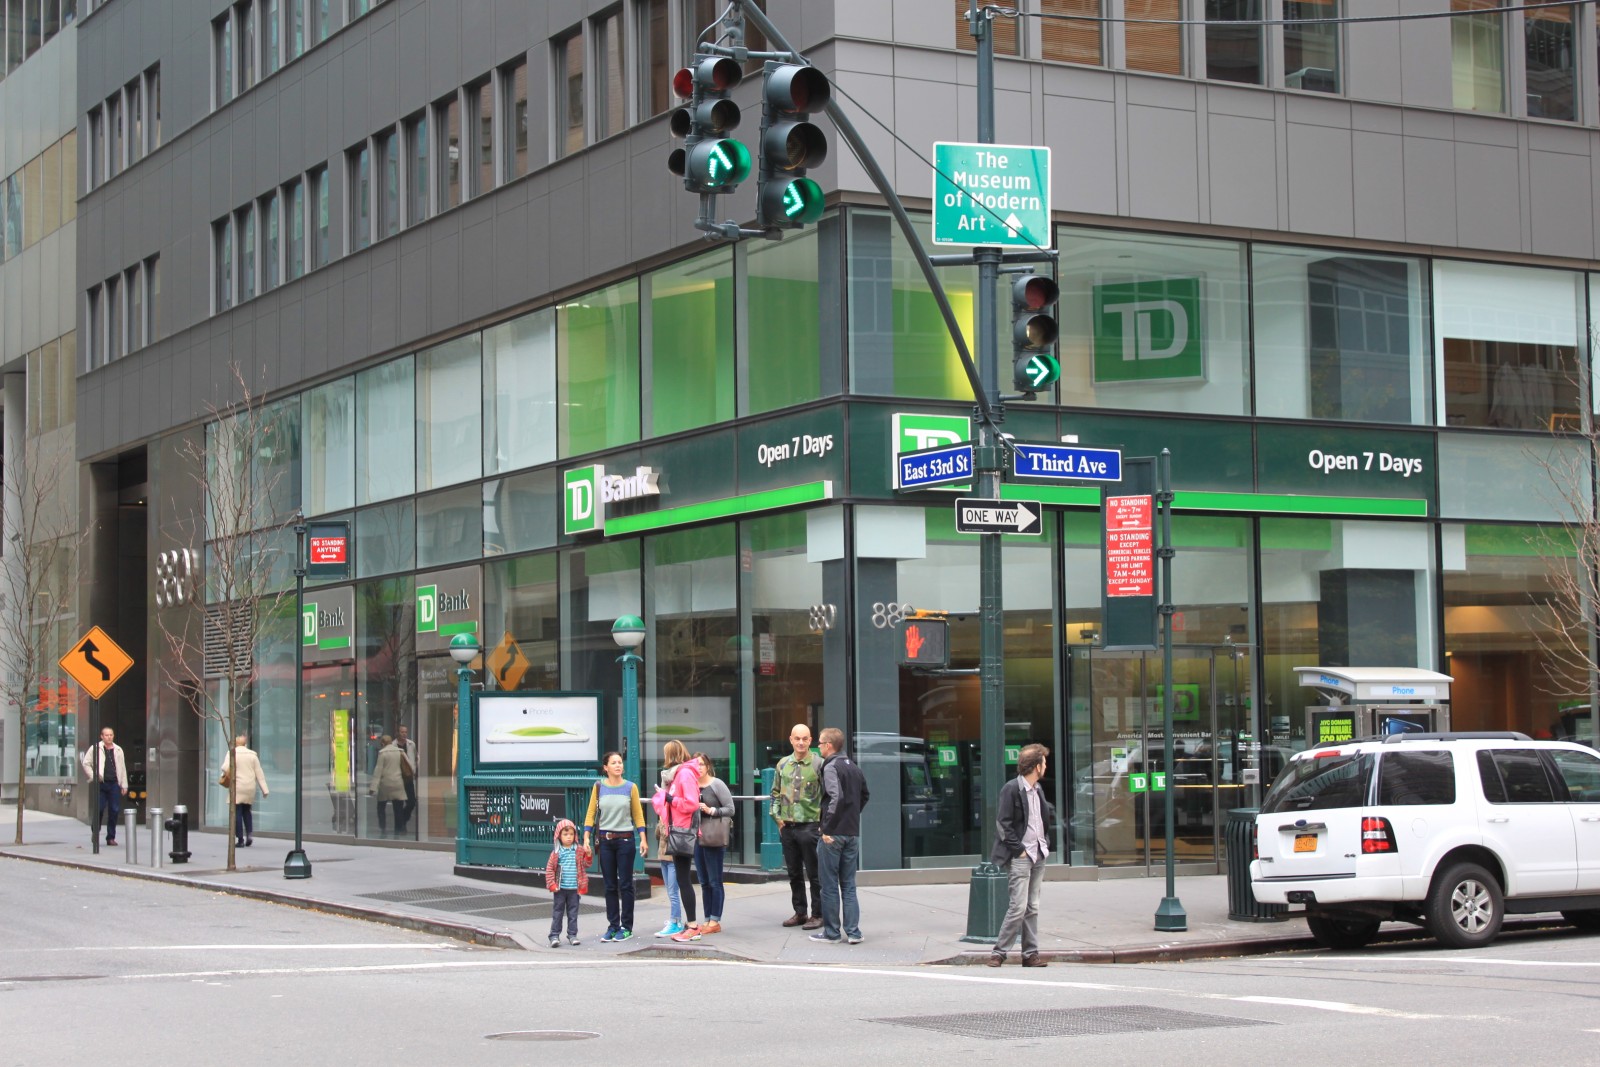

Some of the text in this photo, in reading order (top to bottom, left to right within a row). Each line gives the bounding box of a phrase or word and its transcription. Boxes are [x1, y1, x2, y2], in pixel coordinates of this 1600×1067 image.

[976, 152, 1008, 168] The
[953, 171, 1031, 189] Museum
[944, 190, 1040, 210] of Modern
[957, 214, 986, 231] Art
[1103, 300, 1189, 361] TD
[758, 434, 833, 467] Open 7 Days
[904, 454, 968, 480] East 53rd St
[1028, 452, 1107, 474] Third Ave
[1308, 449, 1423, 477] Open 7 Days
[567, 466, 654, 520] TD Bank
[1121, 498, 1148, 506] STANDING
[966, 509, 1019, 524] ONE WAY
[419, 588, 470, 623] TD Bank
[319, 606, 344, 629] Bank
[1320, 675, 1340, 686] Phone
[1392, 686, 1414, 695] Phone
[1320, 725, 1352, 734] NOW AVAILABLE
[940, 750, 956, 762] TD
[1132, 777, 1146, 789] TD
[520, 794, 550, 814] Subway
